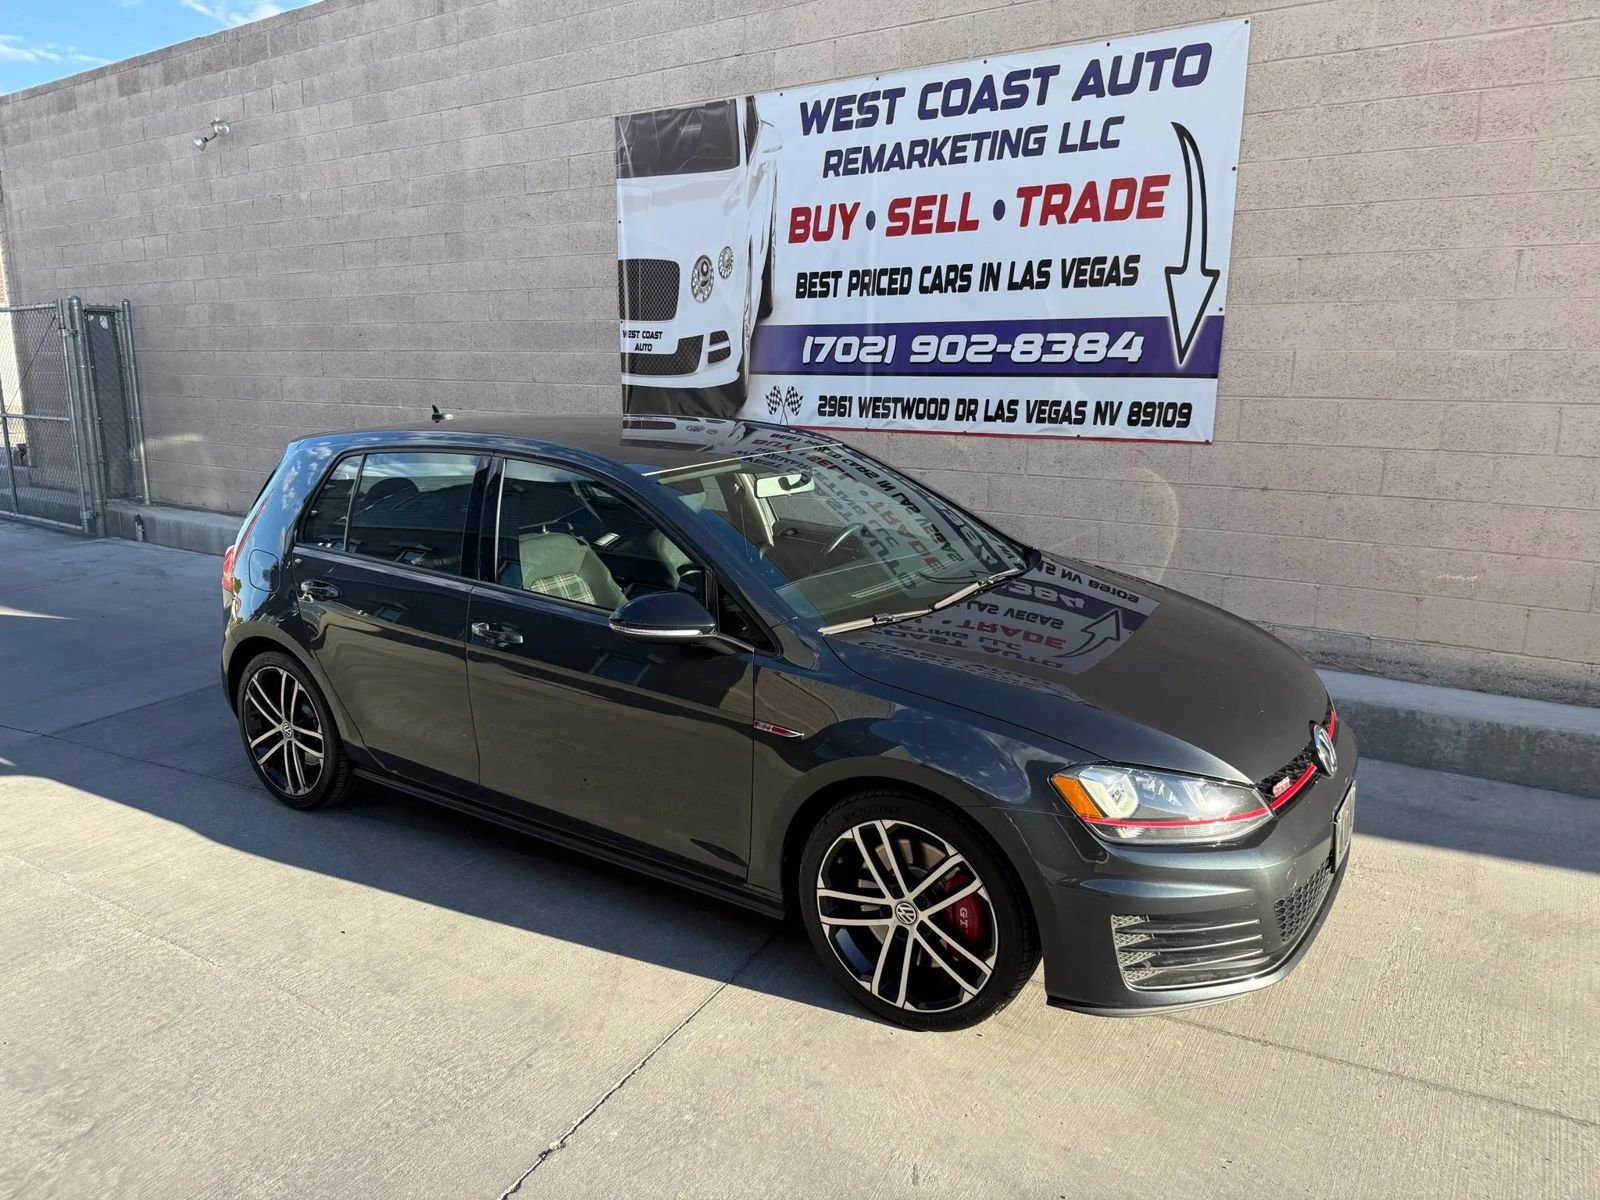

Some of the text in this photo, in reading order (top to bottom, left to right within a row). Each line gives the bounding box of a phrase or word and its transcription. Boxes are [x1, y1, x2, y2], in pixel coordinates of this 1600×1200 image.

[800, 42, 1213, 136] WEST COAST AUTO
[822, 116, 1125, 179] REMARKETING LLC
[788, 174, 1171, 244] BUY SELL TRADE
[795, 254, 1141, 299] BEST PRICED CARS IN LAS VEGAS
[622, 330, 663, 340] WEST COAST
[634, 343, 653, 352] AUTO
[802, 331, 1145, 364] (702) 902-8384
[817, 395, 1193, 429] 2961 WESTWOOD DR LAS VEGAS NV 89109
